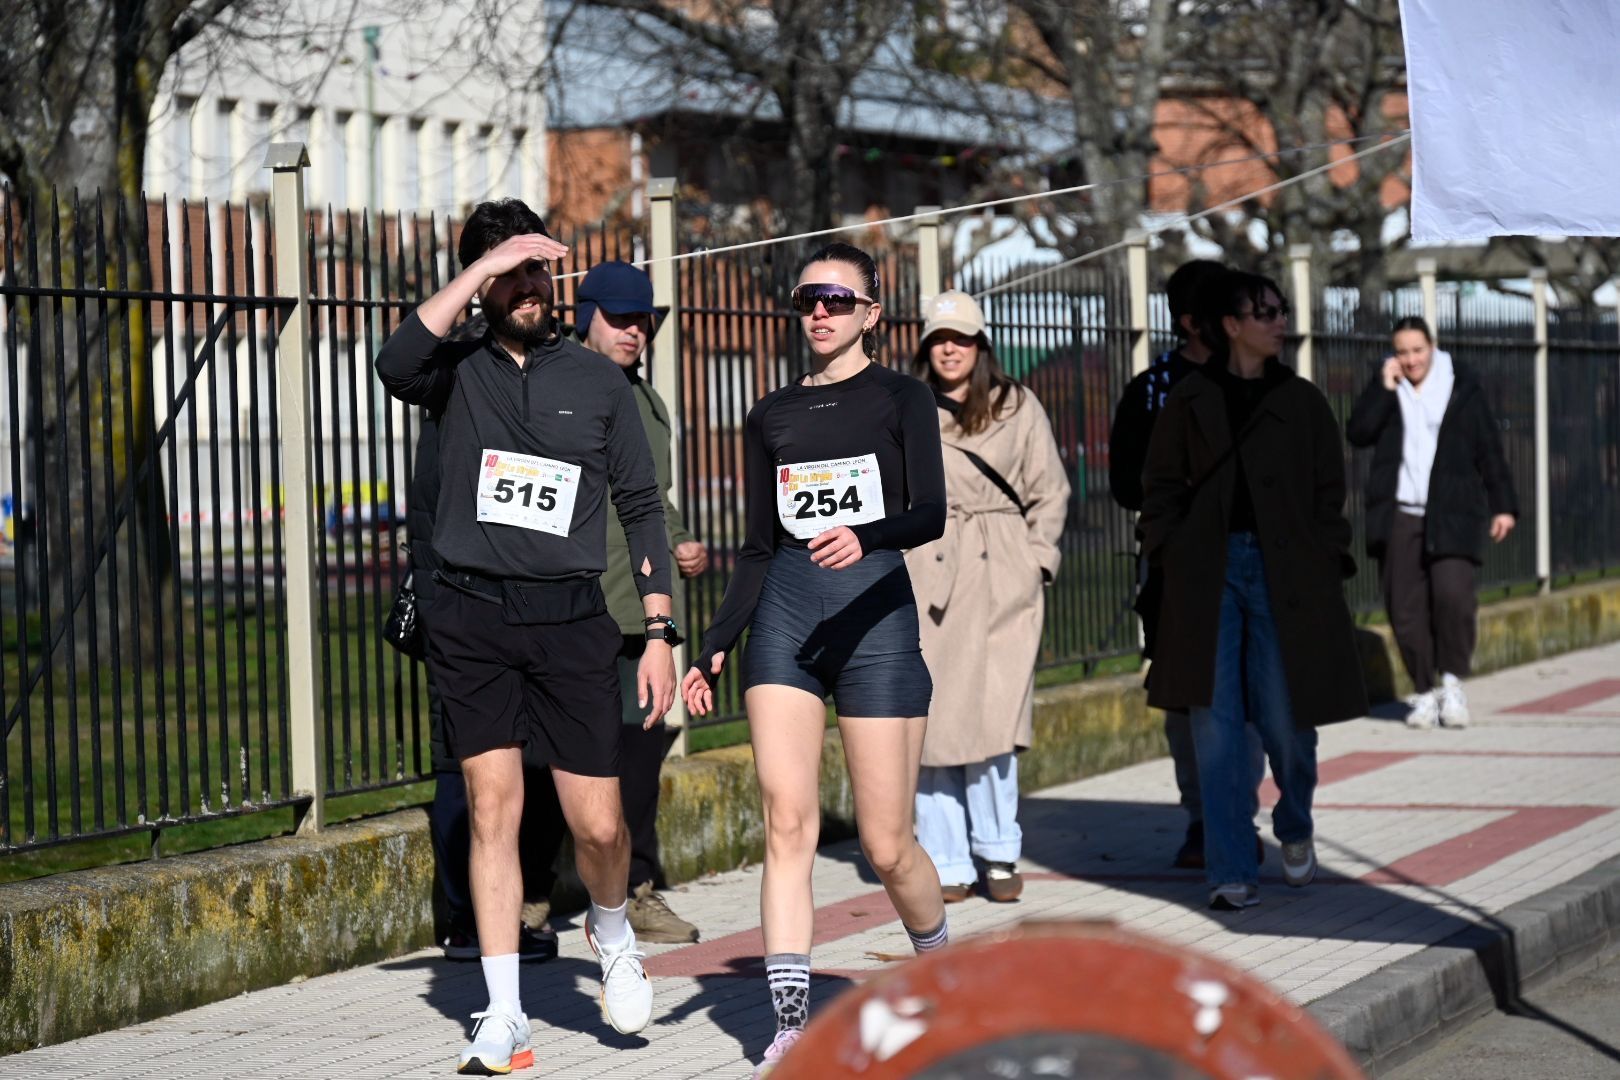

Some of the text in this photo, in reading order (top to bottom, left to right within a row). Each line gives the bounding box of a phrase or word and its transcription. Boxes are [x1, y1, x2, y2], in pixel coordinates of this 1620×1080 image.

[485, 454, 498, 467] 10
[780, 467, 789, 483] 10
[493, 478, 558, 512] 515
[793, 485, 863, 519] 254
